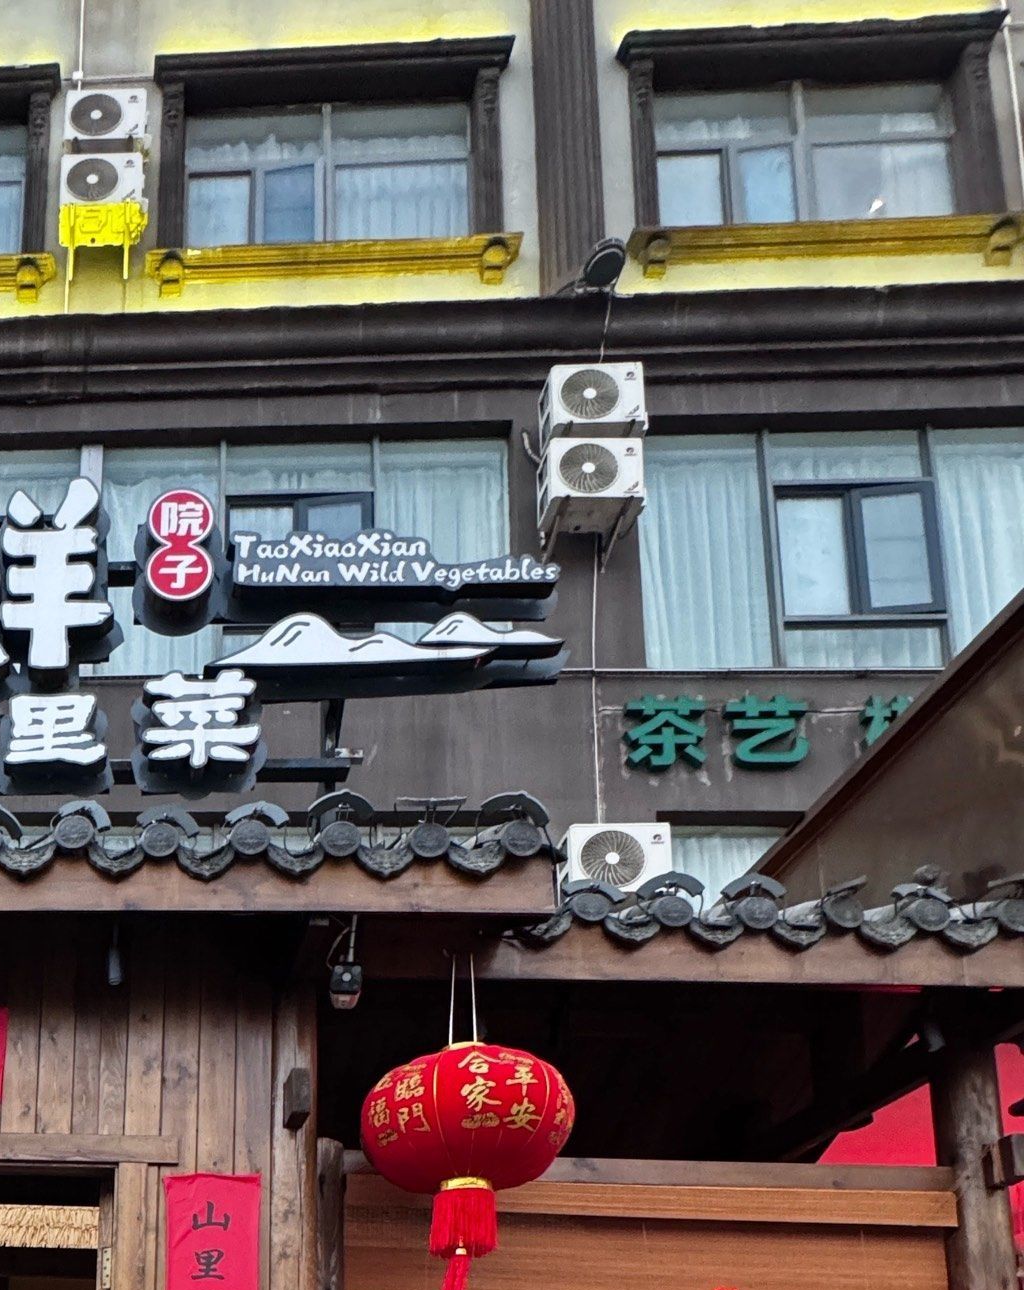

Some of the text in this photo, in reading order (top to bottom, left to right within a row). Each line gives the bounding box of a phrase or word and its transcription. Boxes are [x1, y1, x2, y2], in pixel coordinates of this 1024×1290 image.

[158, 501, 207, 590] 院子
[234, 532, 426, 559] TaoXiaoXian
[238, 558, 557, 586] HuNan Wild Vegetables
